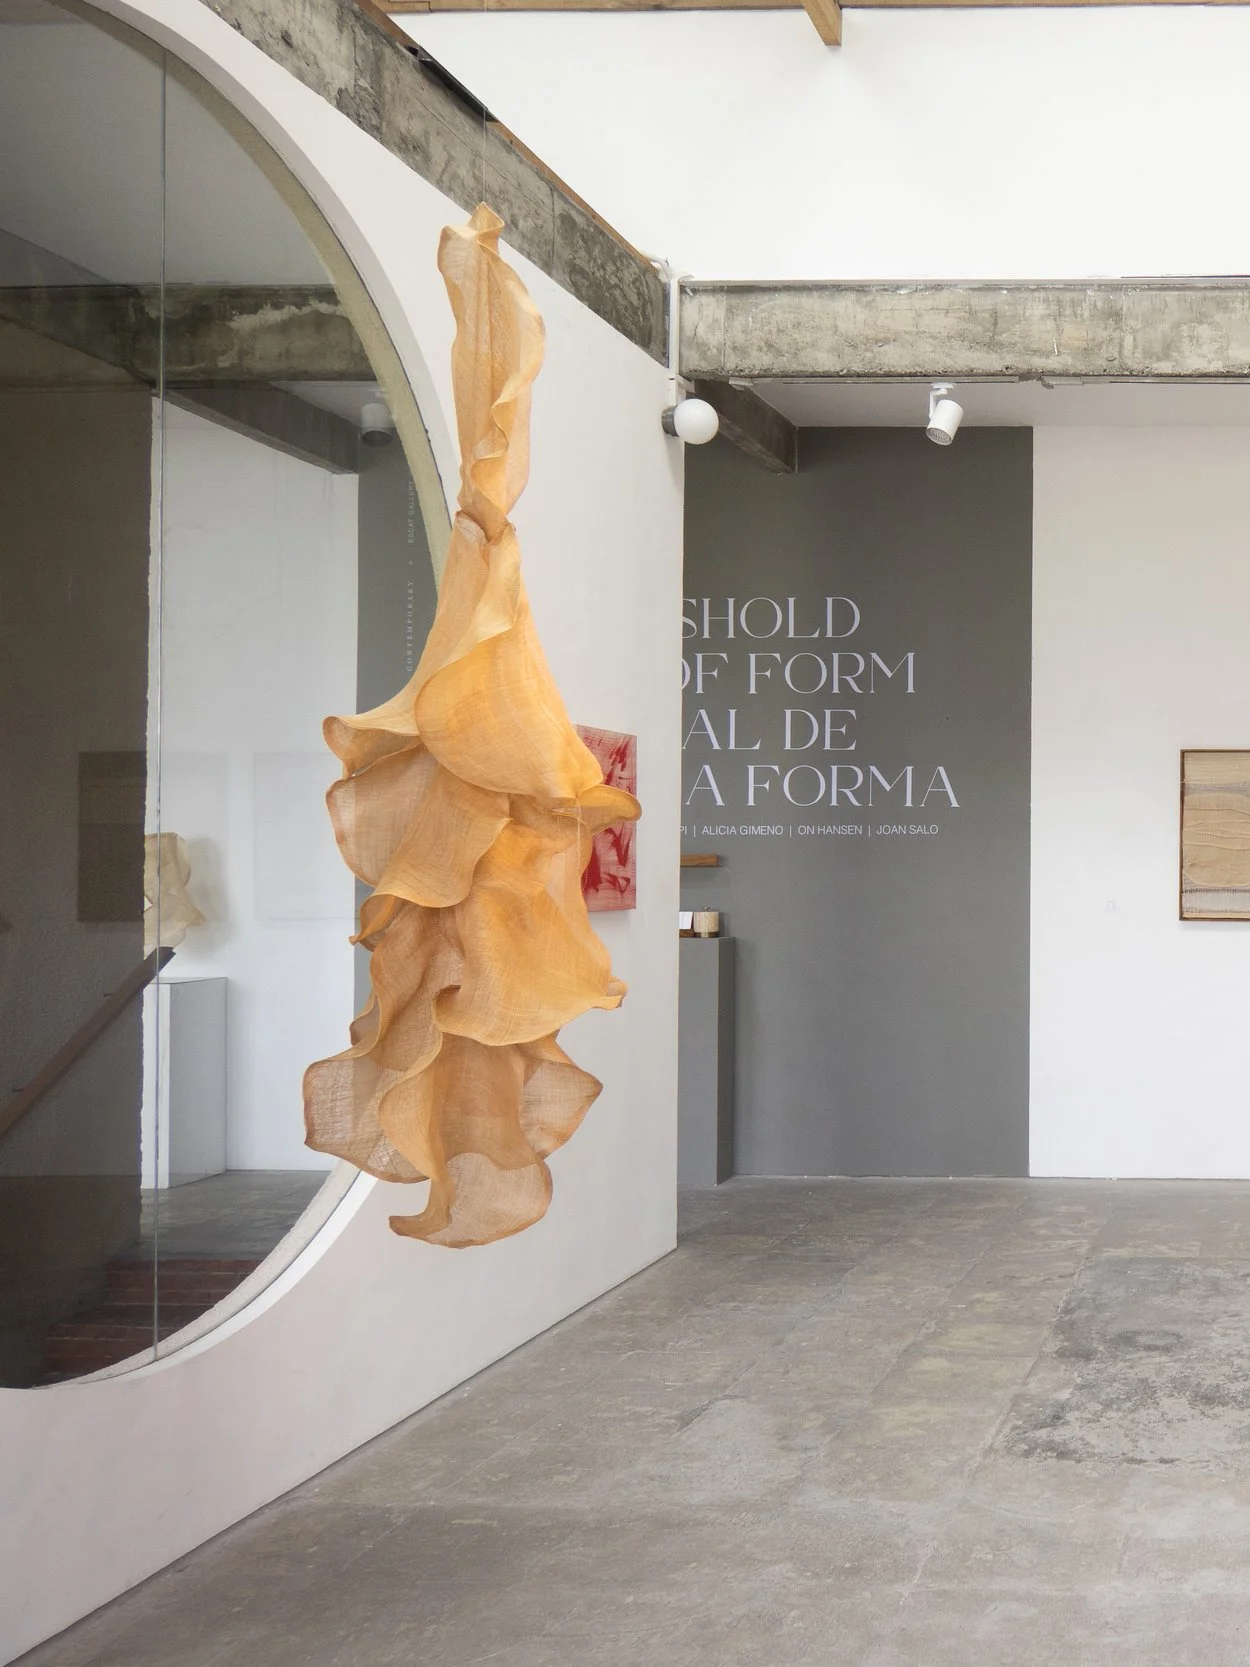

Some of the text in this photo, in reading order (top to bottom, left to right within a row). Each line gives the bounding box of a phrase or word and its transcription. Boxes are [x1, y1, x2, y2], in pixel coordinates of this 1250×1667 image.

[406, 581, 414, 672] CONTEMPORARY
[681, 652, 916, 693] F FORM
[682, 708, 857, 750] AL DE
[684, 764, 961, 807] A FORMA
[701, 825, 737, 836] ALICIA
[739, 825, 784, 836] GIMENO
[797, 825, 815, 836] ON
[817, 824, 863, 836] HANSEN
[876, 824, 907, 836] JOAN
[909, 824, 939, 835] SALO
